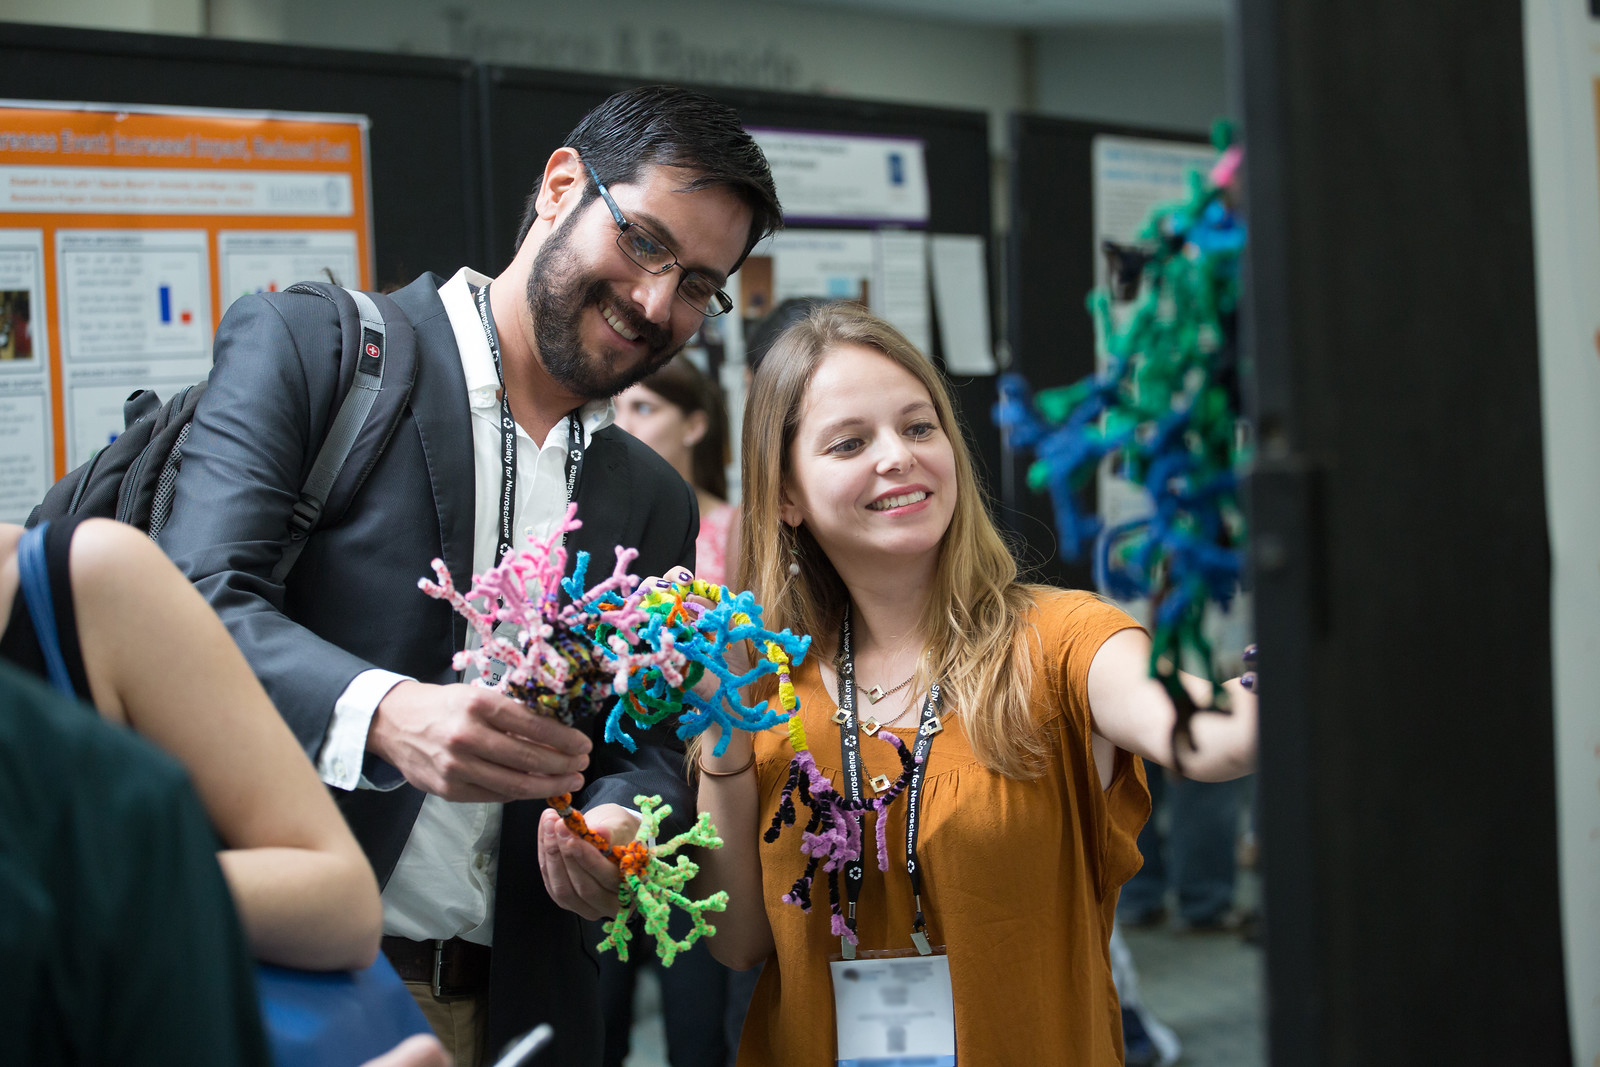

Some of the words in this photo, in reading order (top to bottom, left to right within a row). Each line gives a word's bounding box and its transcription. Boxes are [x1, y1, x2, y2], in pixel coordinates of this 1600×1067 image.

[504, 433, 513, 464] Society
[505, 465, 513, 479] for
[504, 480, 513, 539] Neuroscience
[847, 751, 859, 801] euroscience
[911, 773, 920, 787] for
[907, 791, 918, 854] Neuroscience
